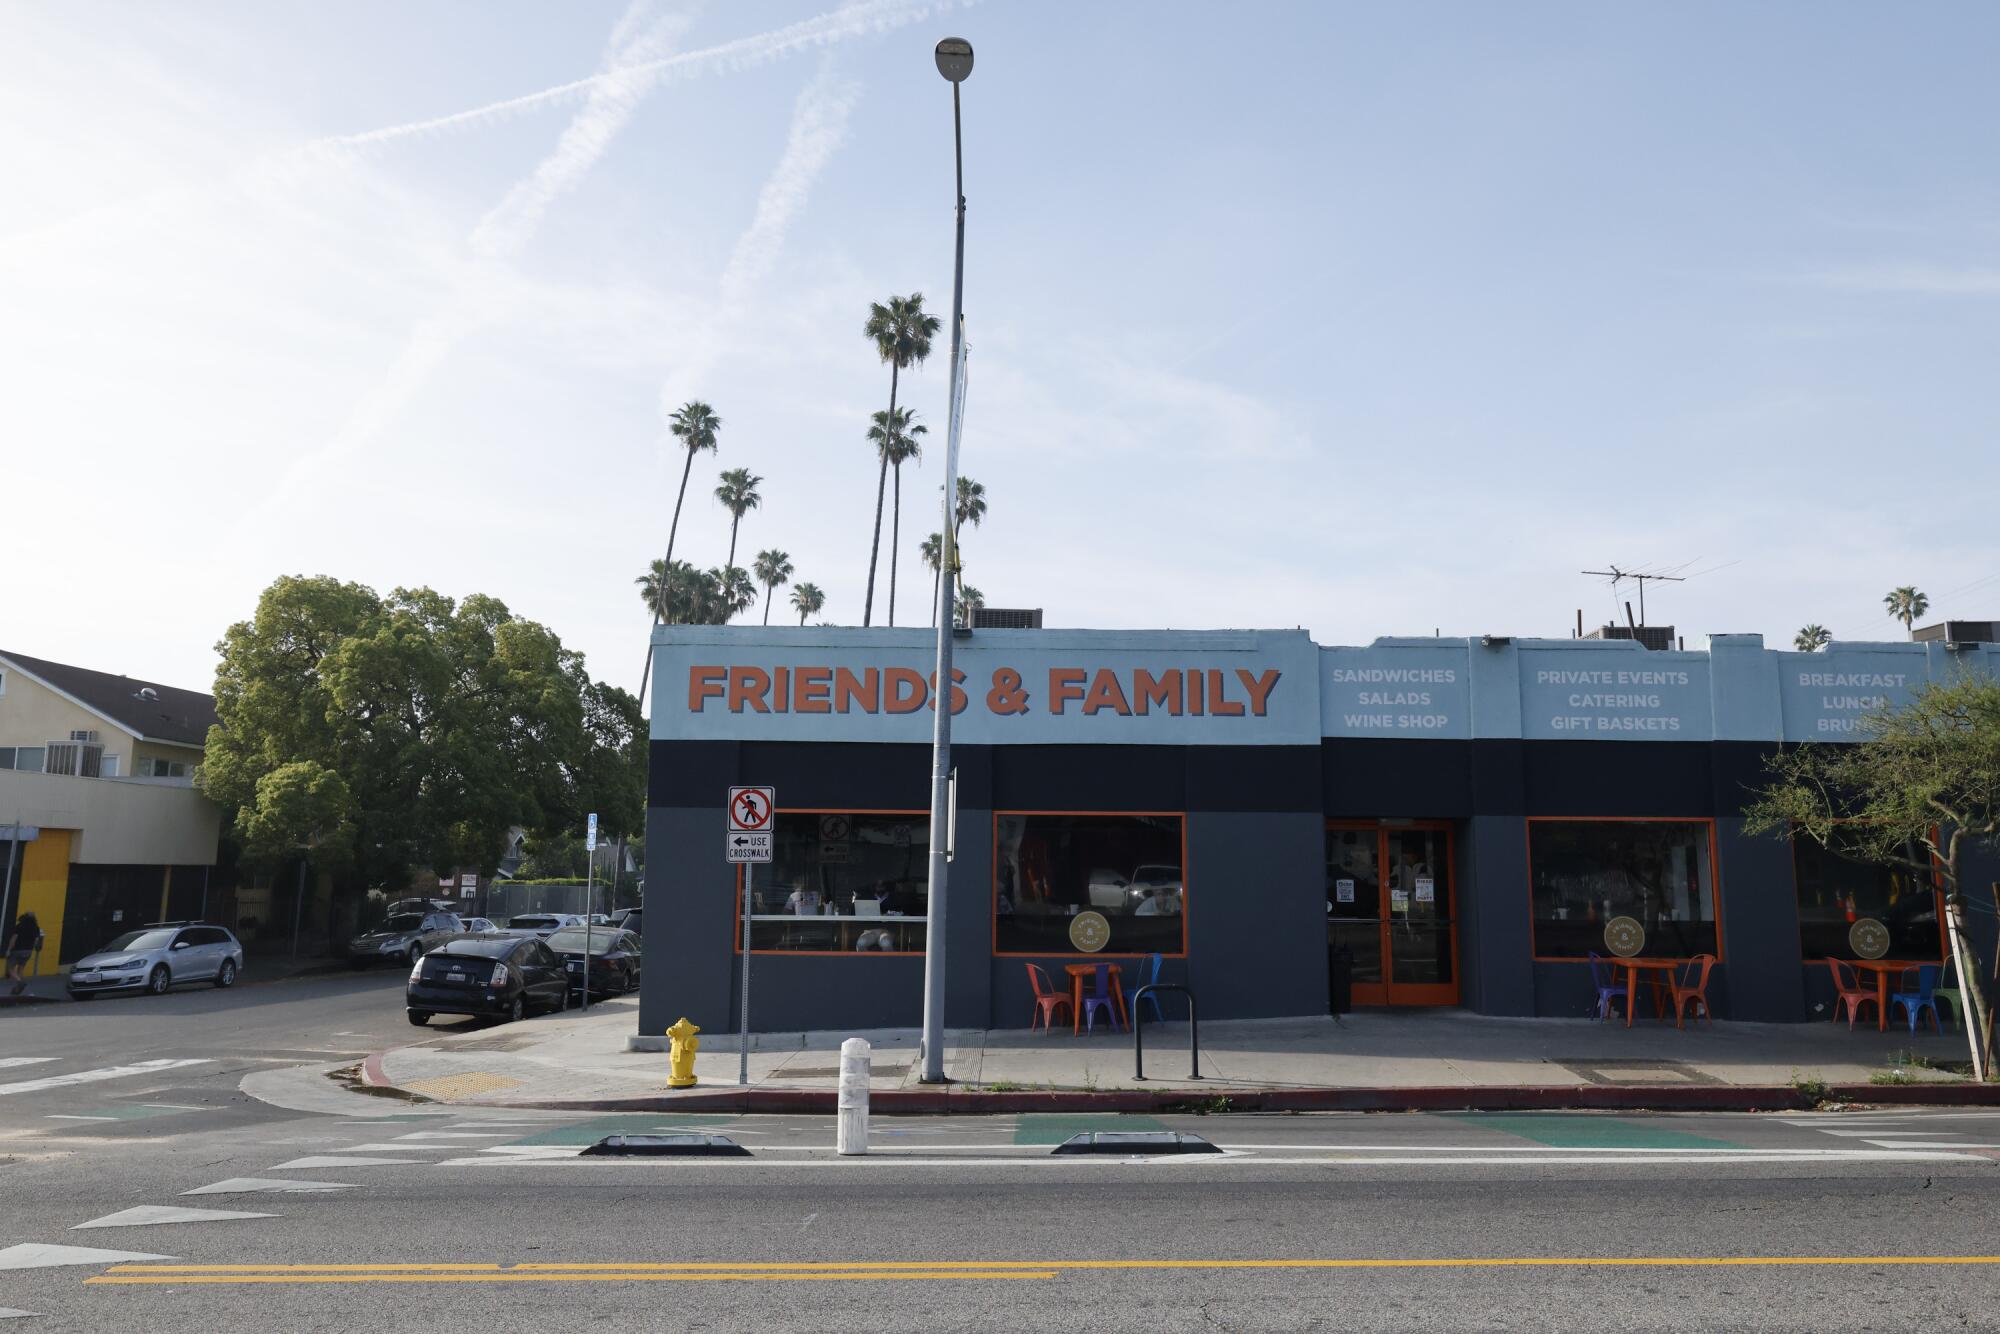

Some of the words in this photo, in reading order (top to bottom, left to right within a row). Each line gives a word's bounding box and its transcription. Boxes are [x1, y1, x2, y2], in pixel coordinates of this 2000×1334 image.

[1333, 669, 1456, 683] SANDWICHES
[1537, 671, 1613, 684] PRIVATE
[1617, 671, 1689, 685] EVENTS
[1799, 673, 1906, 688] BREAKFAST
[687, 666, 968, 715] FRIENDS
[986, 667, 1030, 716] &
[1049, 668, 1282, 716] FAMILY
[1359, 692, 1431, 705] SALADS
[1568, 694, 1660, 708] CATERING
[1823, 696, 1886, 709] LUNCH
[1343, 714, 1393, 728] WINE
[1397, 714, 1448, 728] SHOP
[1551, 716, 1592, 730] GIFT
[1597, 717, 1681, 731] BASKETS
[750, 837, 767, 847] USE
[729, 848, 769, 858] CROSSWALK
